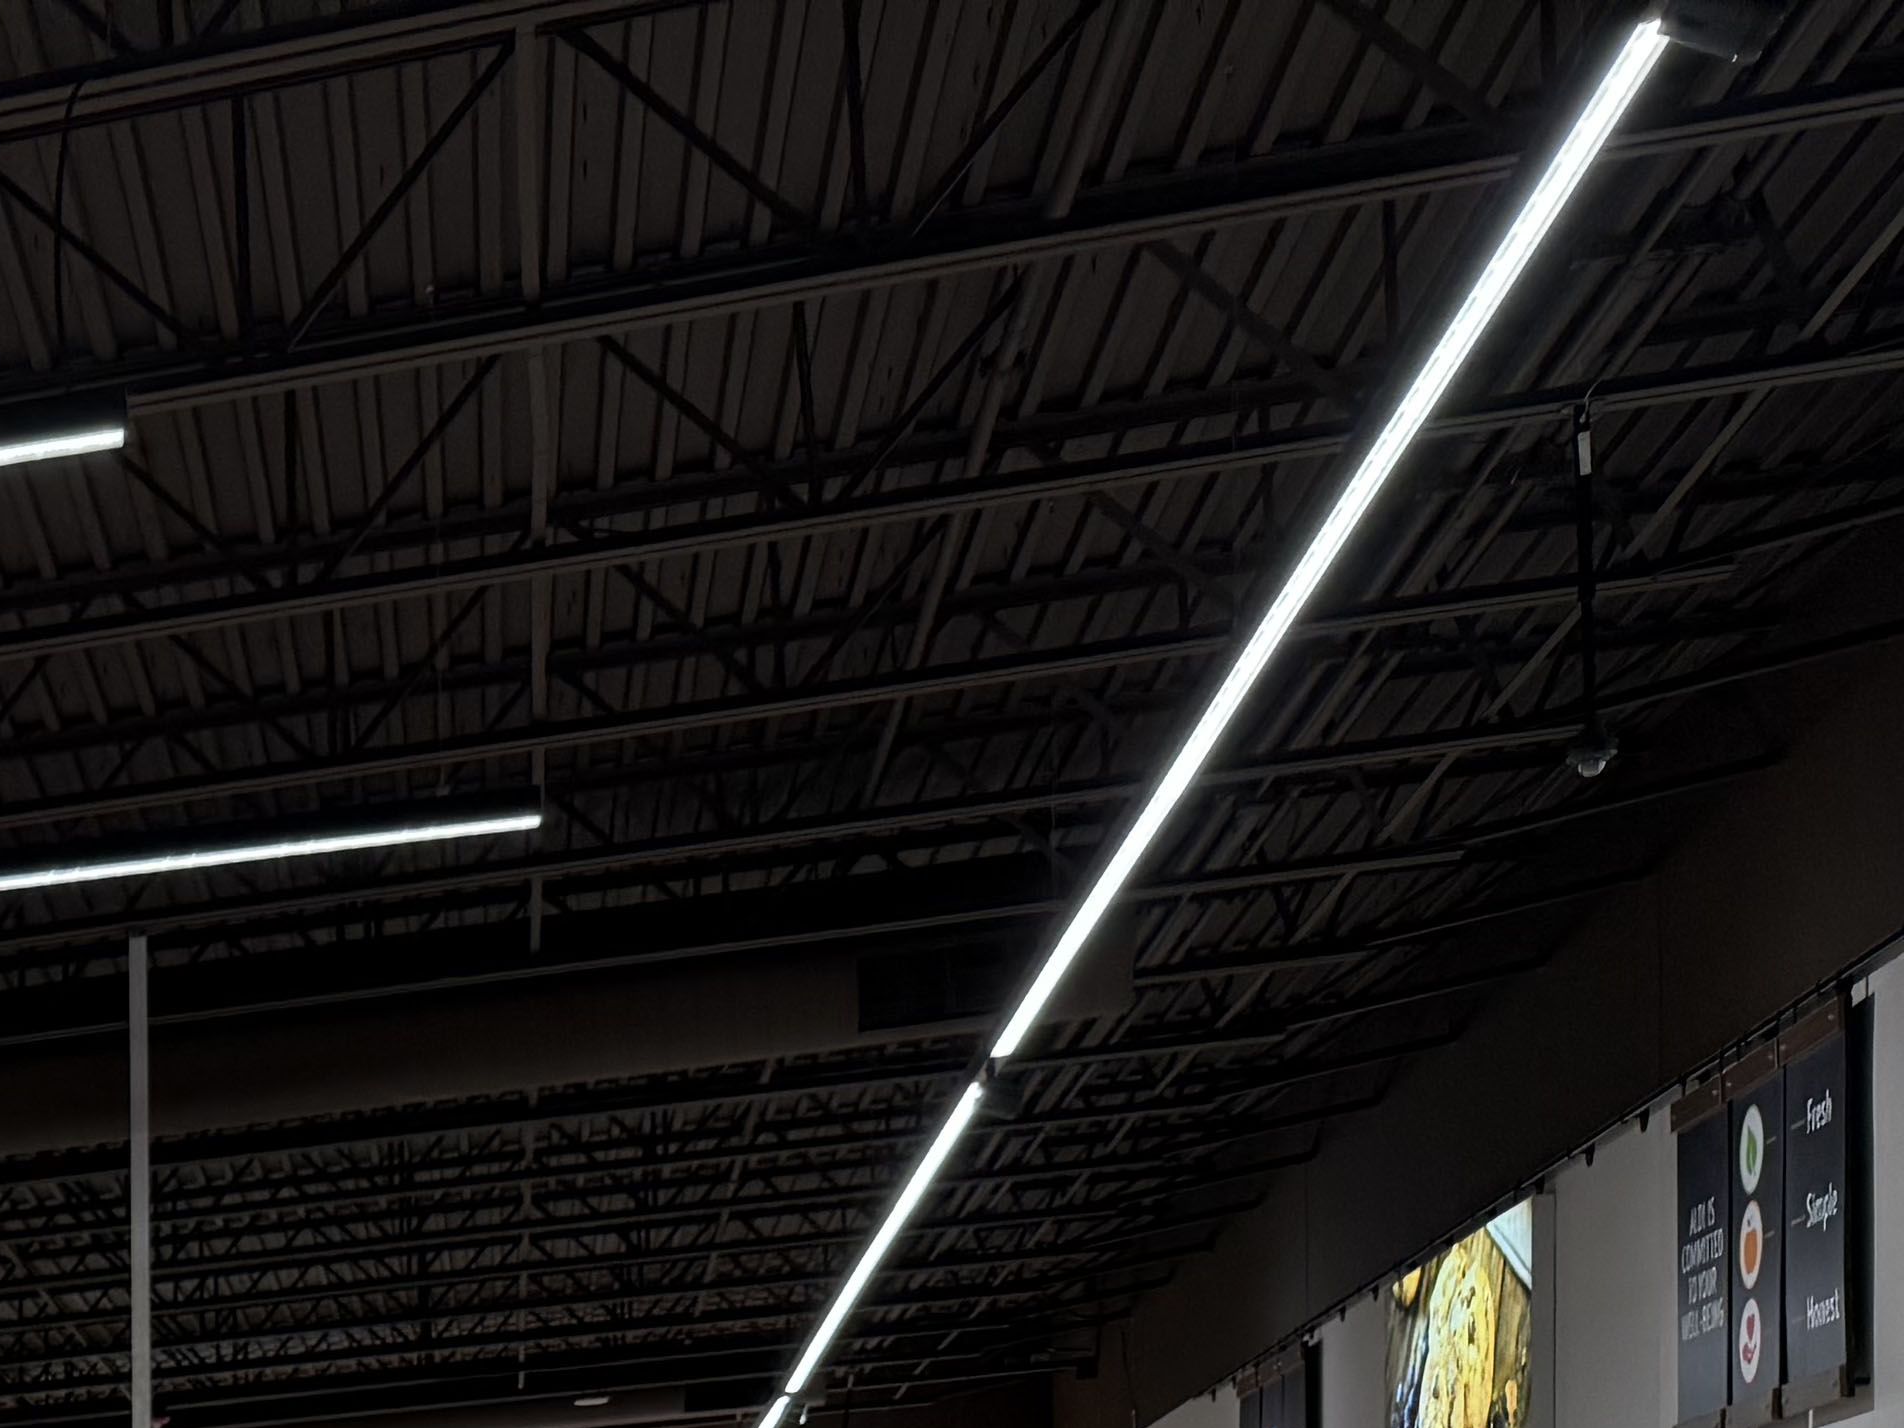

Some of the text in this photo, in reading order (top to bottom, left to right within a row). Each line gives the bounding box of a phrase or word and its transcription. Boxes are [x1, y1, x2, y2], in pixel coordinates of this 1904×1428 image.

[1806, 1089, 1833, 1134] Fresh
[1806, 1182, 1839, 1232] Simple
[1806, 1288, 1840, 1331] Honest
